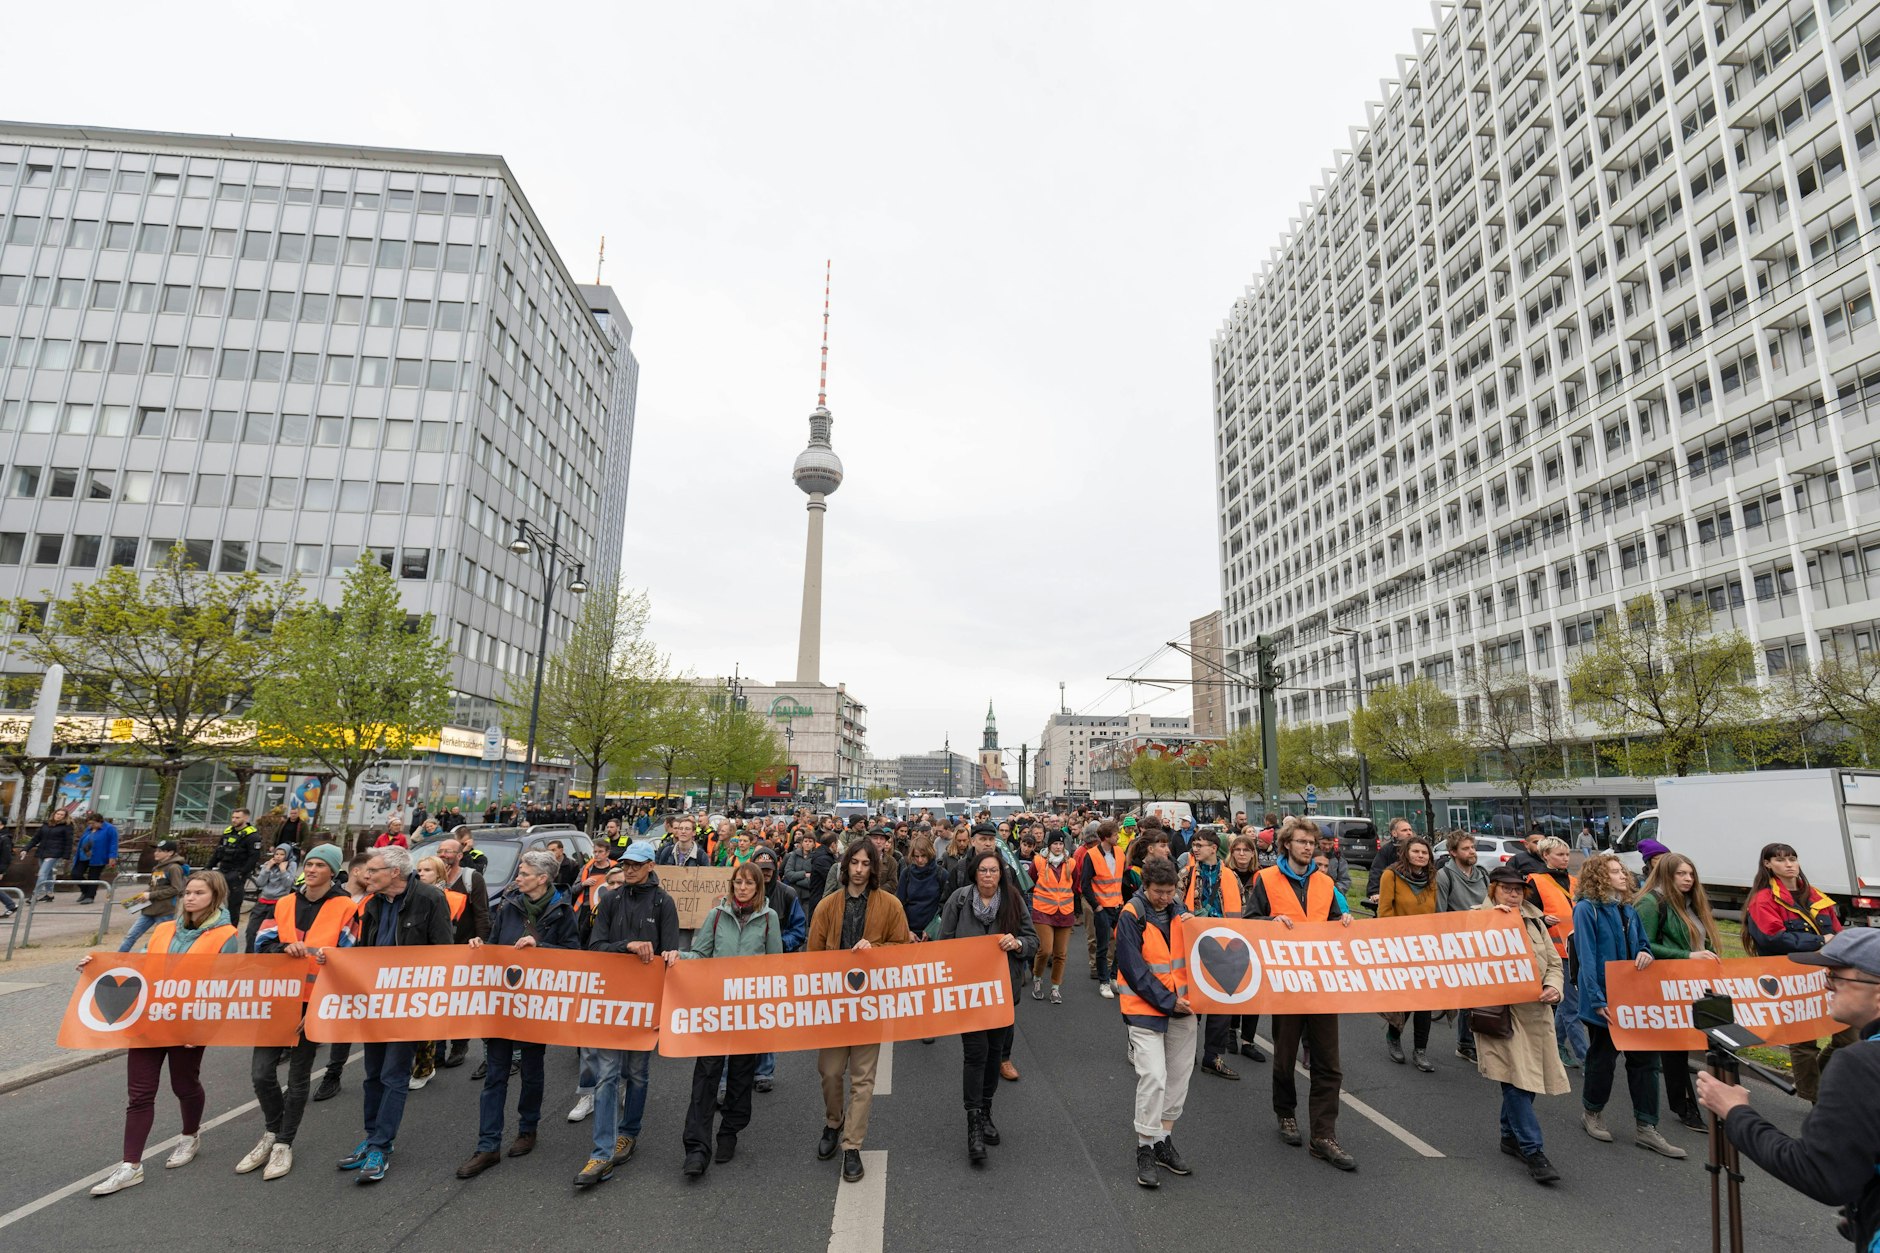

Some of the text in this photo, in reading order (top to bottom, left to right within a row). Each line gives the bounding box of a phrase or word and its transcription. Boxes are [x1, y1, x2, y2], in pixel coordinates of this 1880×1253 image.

[776, 706, 813, 718] GALERIA
[442, 734, 486, 750] Verkehrssicher
[1259, 928, 1527, 966] LETZTE GENERATION
[153, 979, 302, 999] 100 KM/H UND
[375, 965, 447, 989] MEHR
[723, 975, 788, 1001] MEHR
[1266, 958, 1535, 993] VOR DEN KIPPPUNKTEN
[1712, 969, 1827, 999] DEMOKRATI
[148, 999, 272, 1022] 9€ FÜR ALLE
[318, 991, 655, 1028] GESELLSCHAFTSRAT JETZT!
[670, 979, 1005, 1034] GESELLSCHAFTSRAT JETZT!
[1616, 995, 1822, 1030] GESELLAFTSRAT
